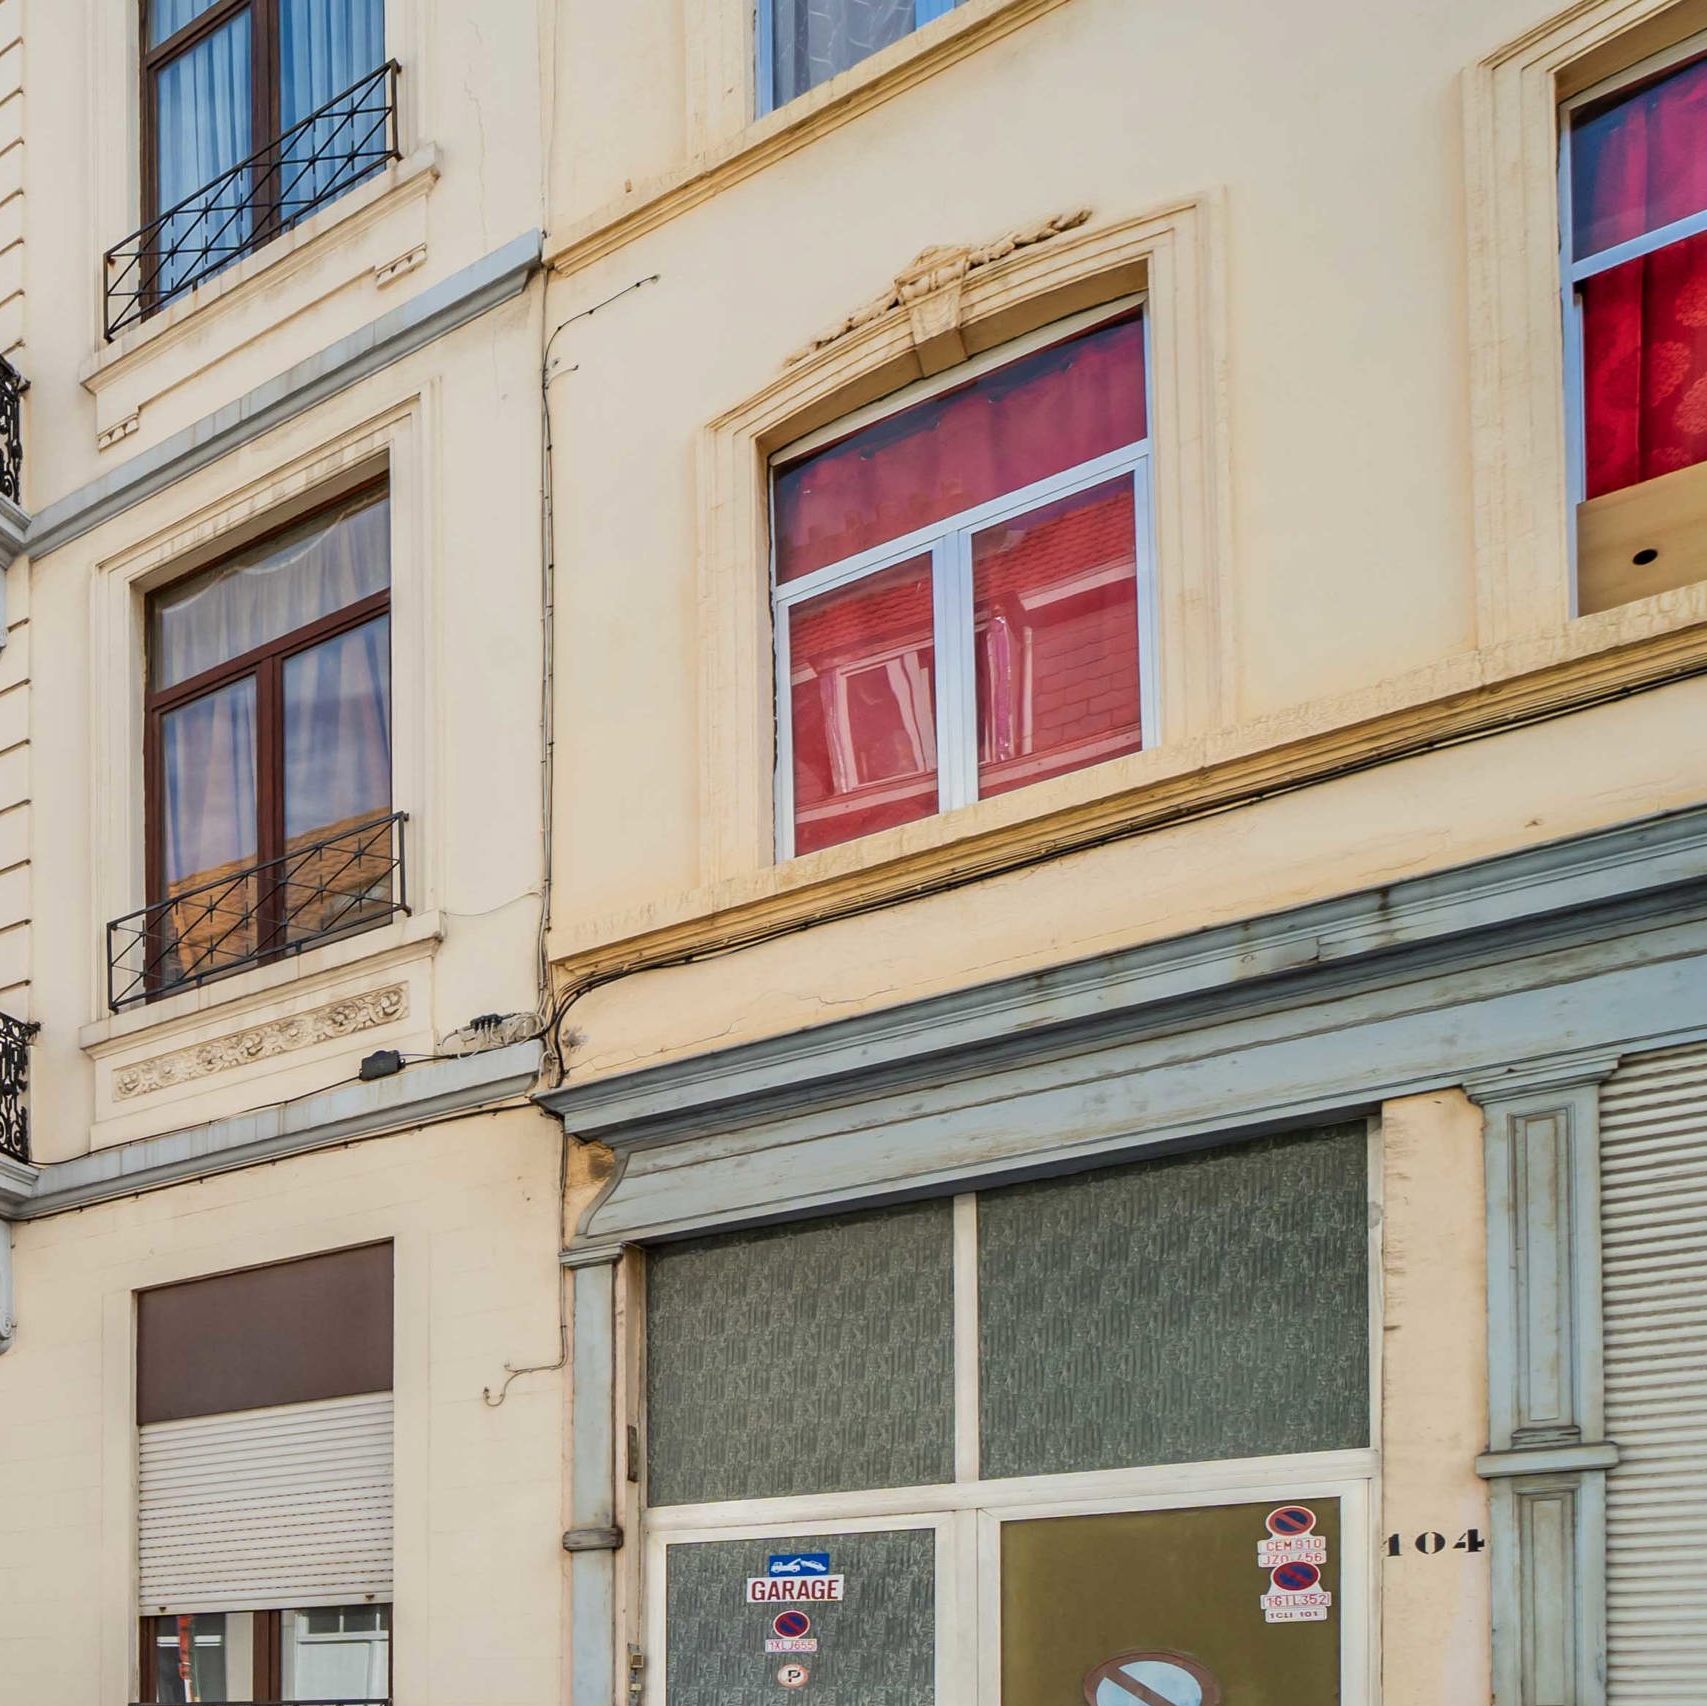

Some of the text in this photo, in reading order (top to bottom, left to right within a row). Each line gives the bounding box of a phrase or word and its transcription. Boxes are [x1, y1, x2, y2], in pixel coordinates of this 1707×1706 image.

[1266, 1541, 1292, 1552] CEM
[1383, 1529, 1485, 1557] 104
[751, 1579, 839, 1601] GARAGE
